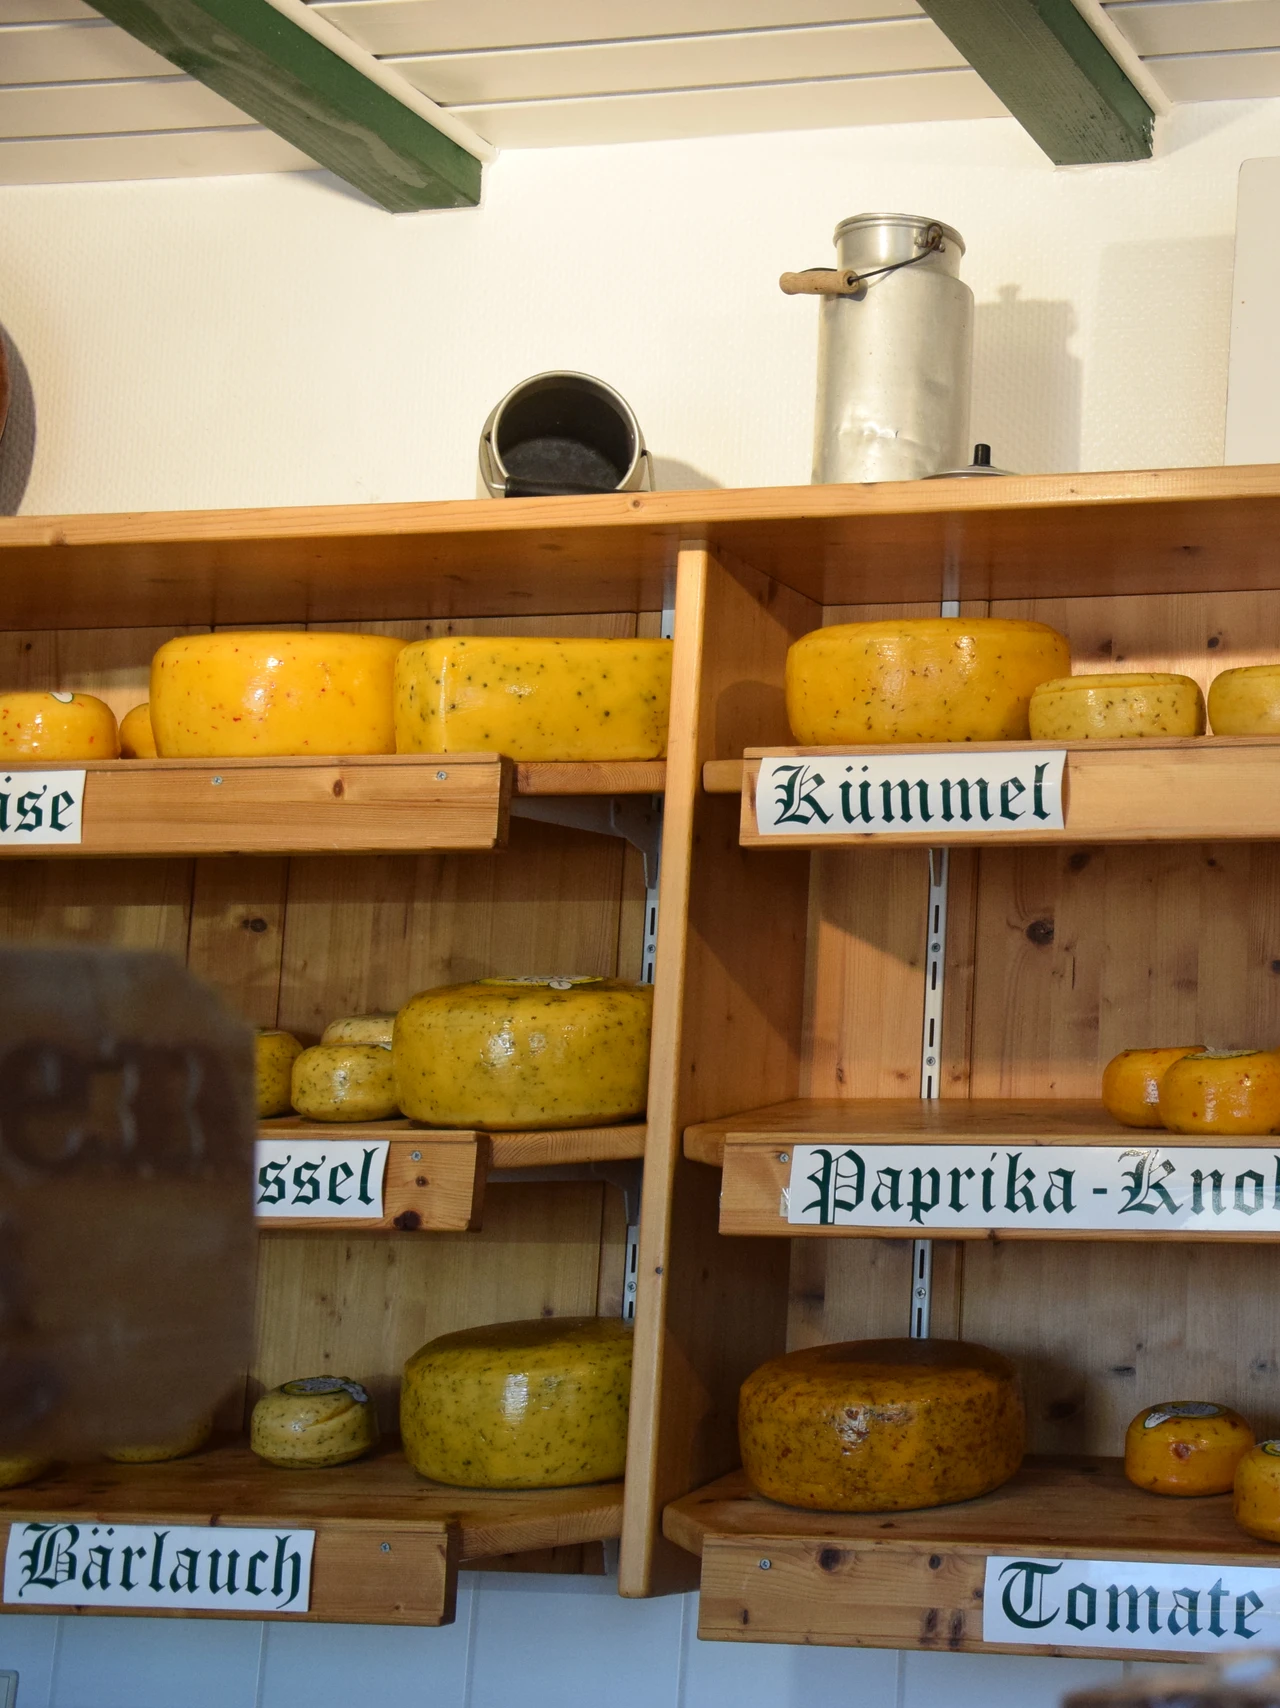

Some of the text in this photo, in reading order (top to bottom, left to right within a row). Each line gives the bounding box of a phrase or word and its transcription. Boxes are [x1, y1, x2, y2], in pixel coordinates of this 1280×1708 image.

[771, 762, 1051, 826] Kümmel
[256, 1146, 380, 1206] ssel
[17, 1522, 302, 1610] Bärlauch
